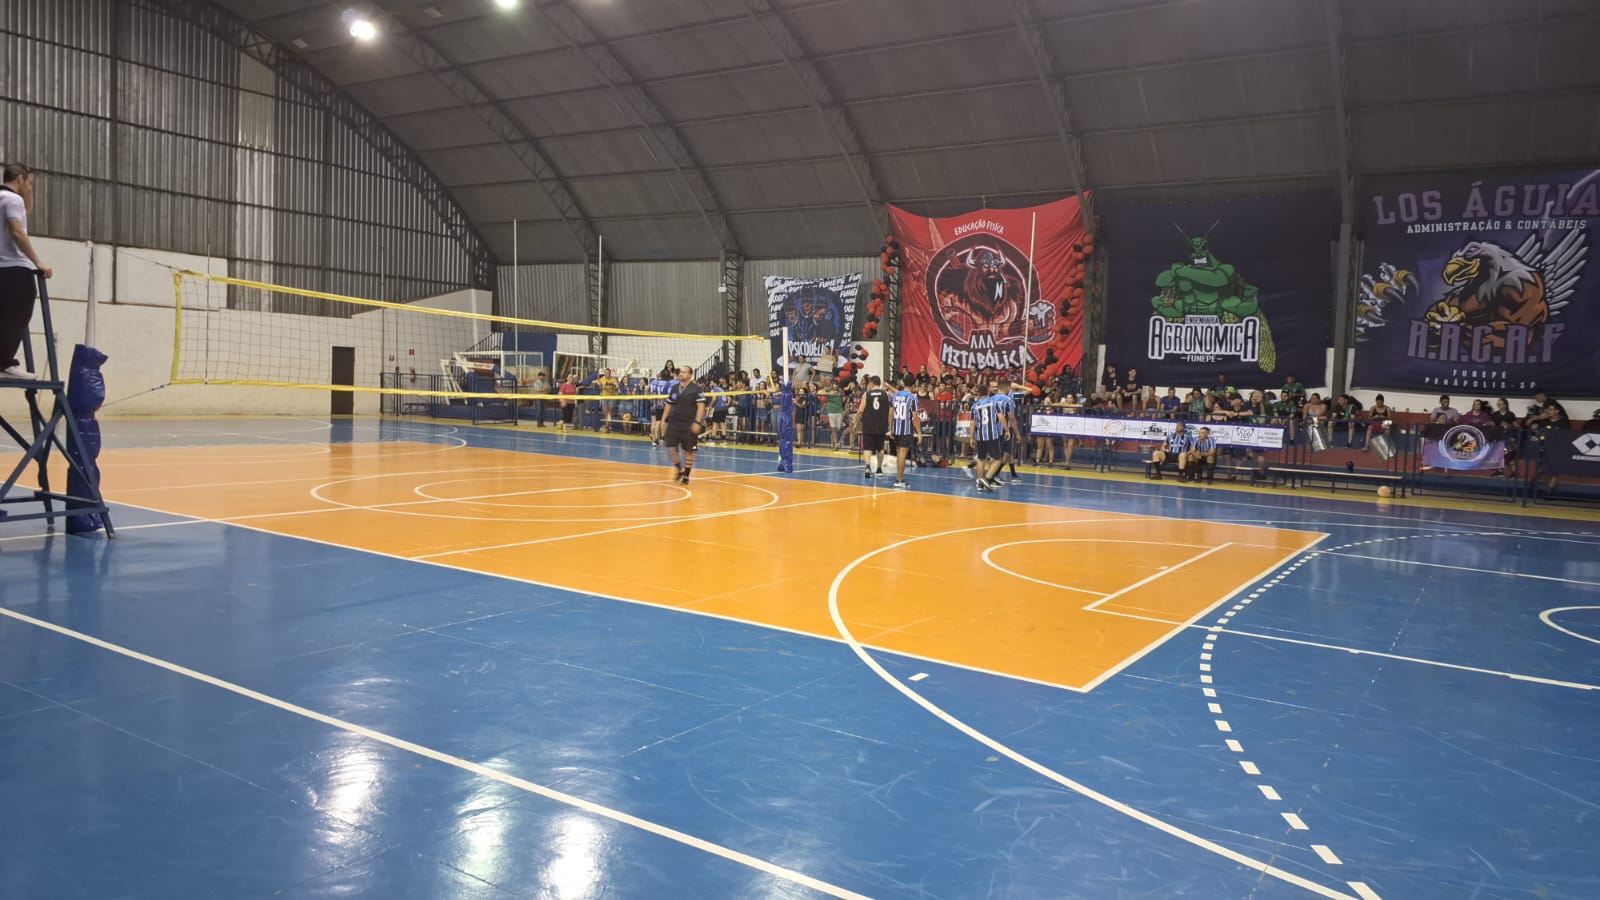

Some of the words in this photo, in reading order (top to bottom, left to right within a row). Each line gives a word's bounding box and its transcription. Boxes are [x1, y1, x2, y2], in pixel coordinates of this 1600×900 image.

[1374, 190, 1442, 225] LOS
[954, 219, 986, 236] EDUCAÇÃO
[1406, 219, 1500, 234] ADMINISTRAÇÃO
[1504, 220, 1513, 230] &
[1186, 355, 1217, 363] FUNEPE
[873, 397, 880, 410] 6
[894, 401, 906, 420] 30
